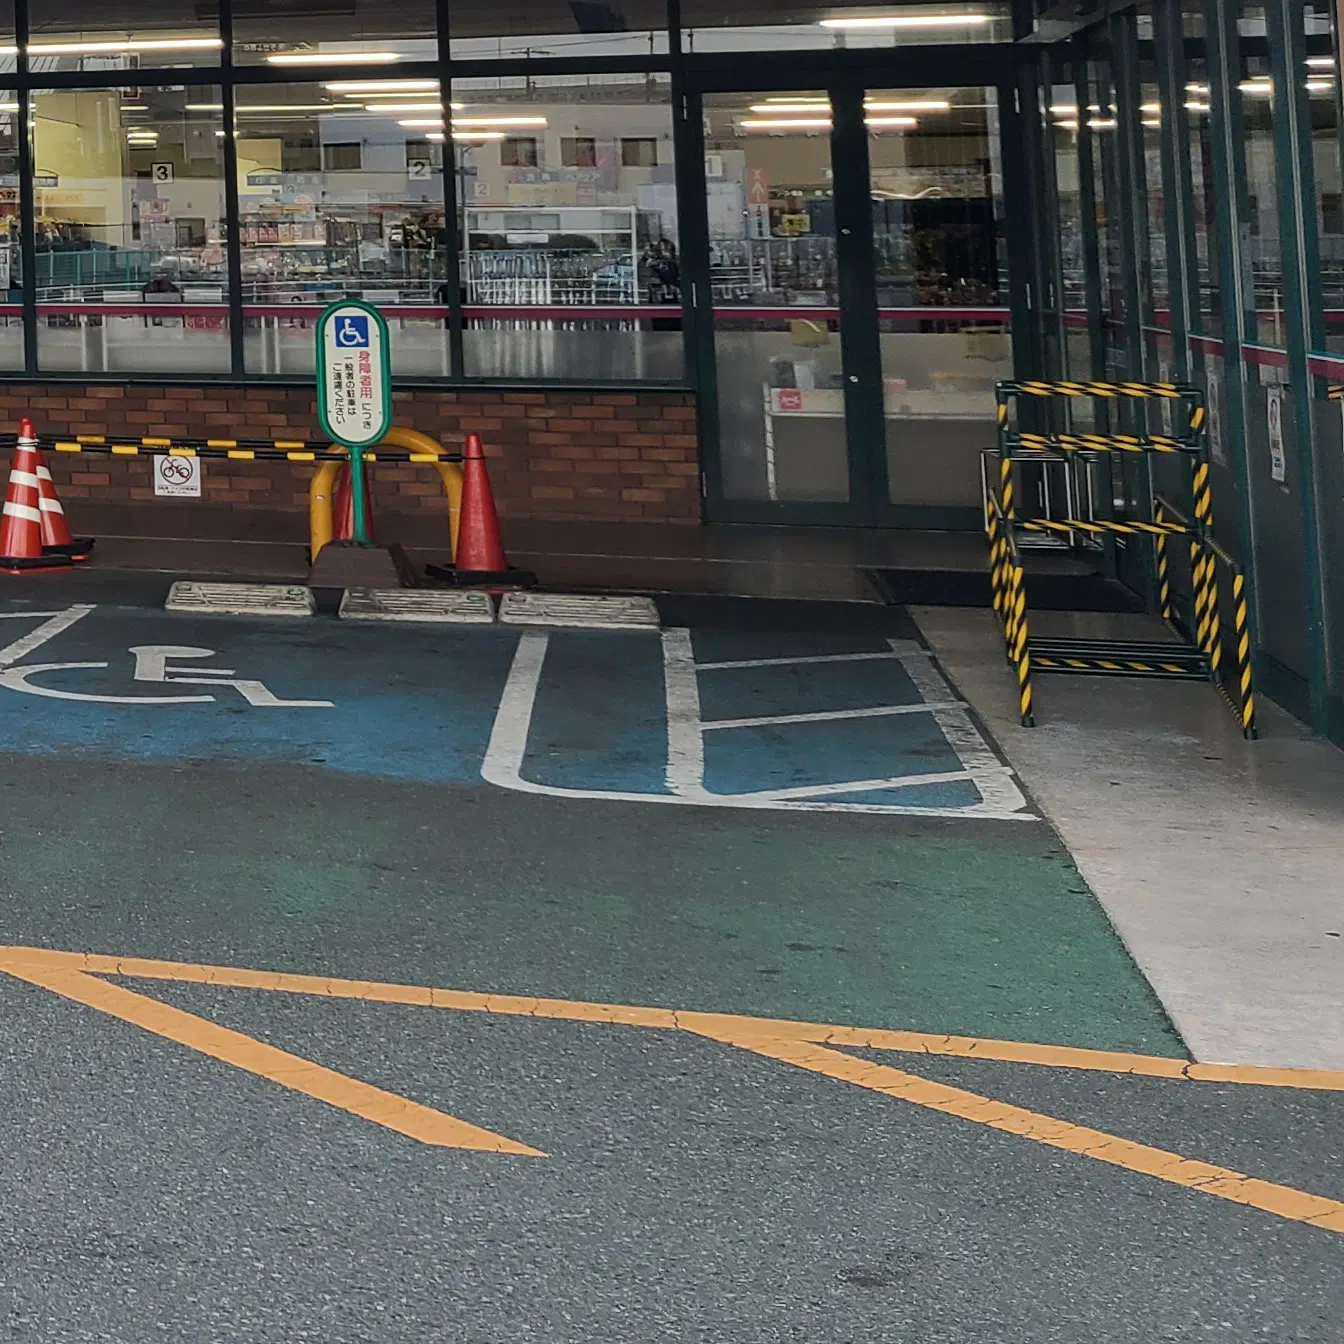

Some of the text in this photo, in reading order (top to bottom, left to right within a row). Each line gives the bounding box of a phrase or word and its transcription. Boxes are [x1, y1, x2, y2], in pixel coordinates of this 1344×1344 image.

[156, 165, 168, 180] 3
[414, 161, 426, 175] 2
[332, 362, 346, 425] ご遠慮ください
[343, 356, 357, 416] 一般者の駐車は
[358, 350, 373, 430] 身障者用につき
